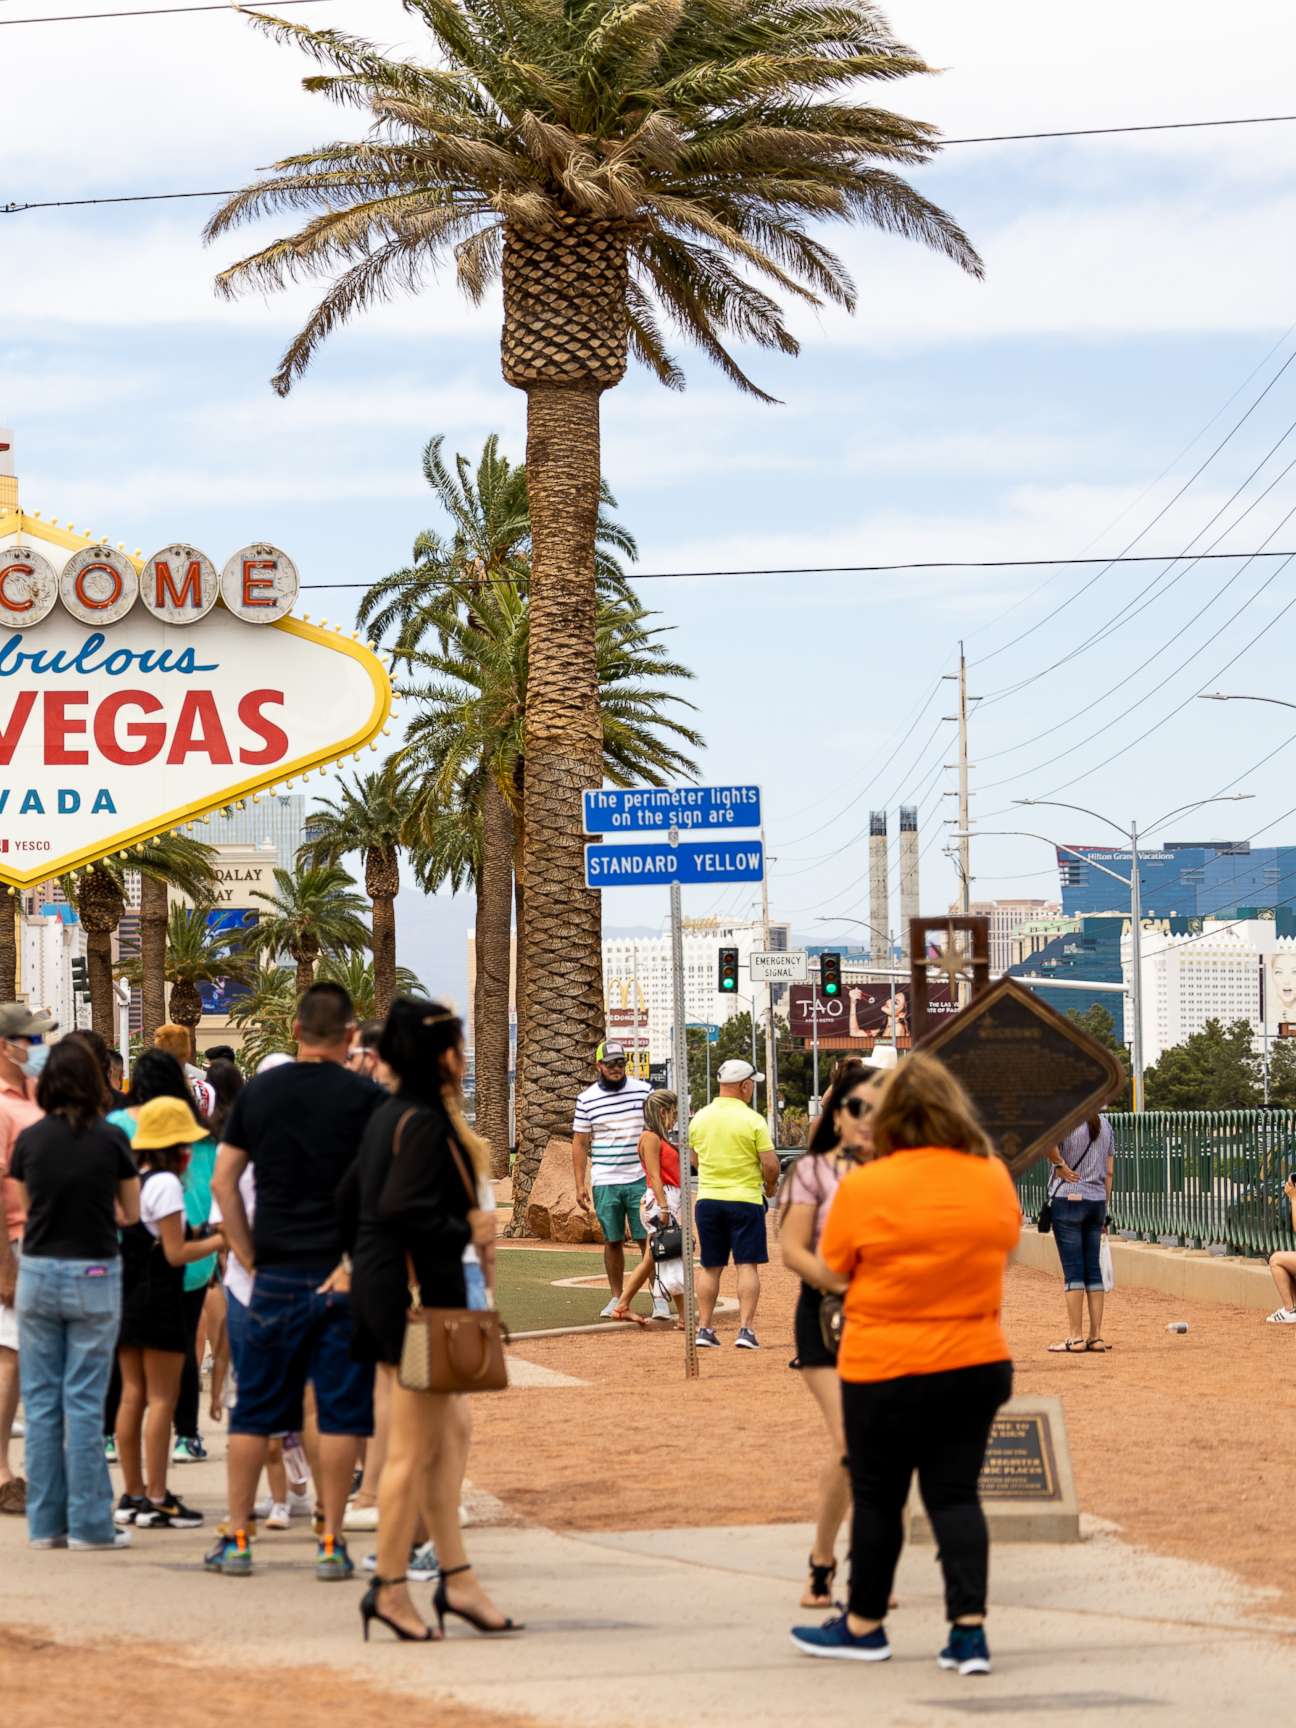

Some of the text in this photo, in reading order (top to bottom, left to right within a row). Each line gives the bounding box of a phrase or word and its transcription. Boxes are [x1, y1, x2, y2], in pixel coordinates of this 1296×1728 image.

[588, 787, 757, 812] The perimeter lights
[612, 808, 735, 828] on the sign are
[14, 840, 51, 851] YESCO
[1087, 852, 1112, 861] Hilton
[1137, 852, 1175, 861] Vacations
[590, 852, 761, 875] STANDARD YELLOW
[215, 868, 264, 881] DALAY
[755, 956, 802, 966] EMERGENCY
[765, 967, 794, 978] SIGNAL
[795, 999, 843, 1018] TAO
